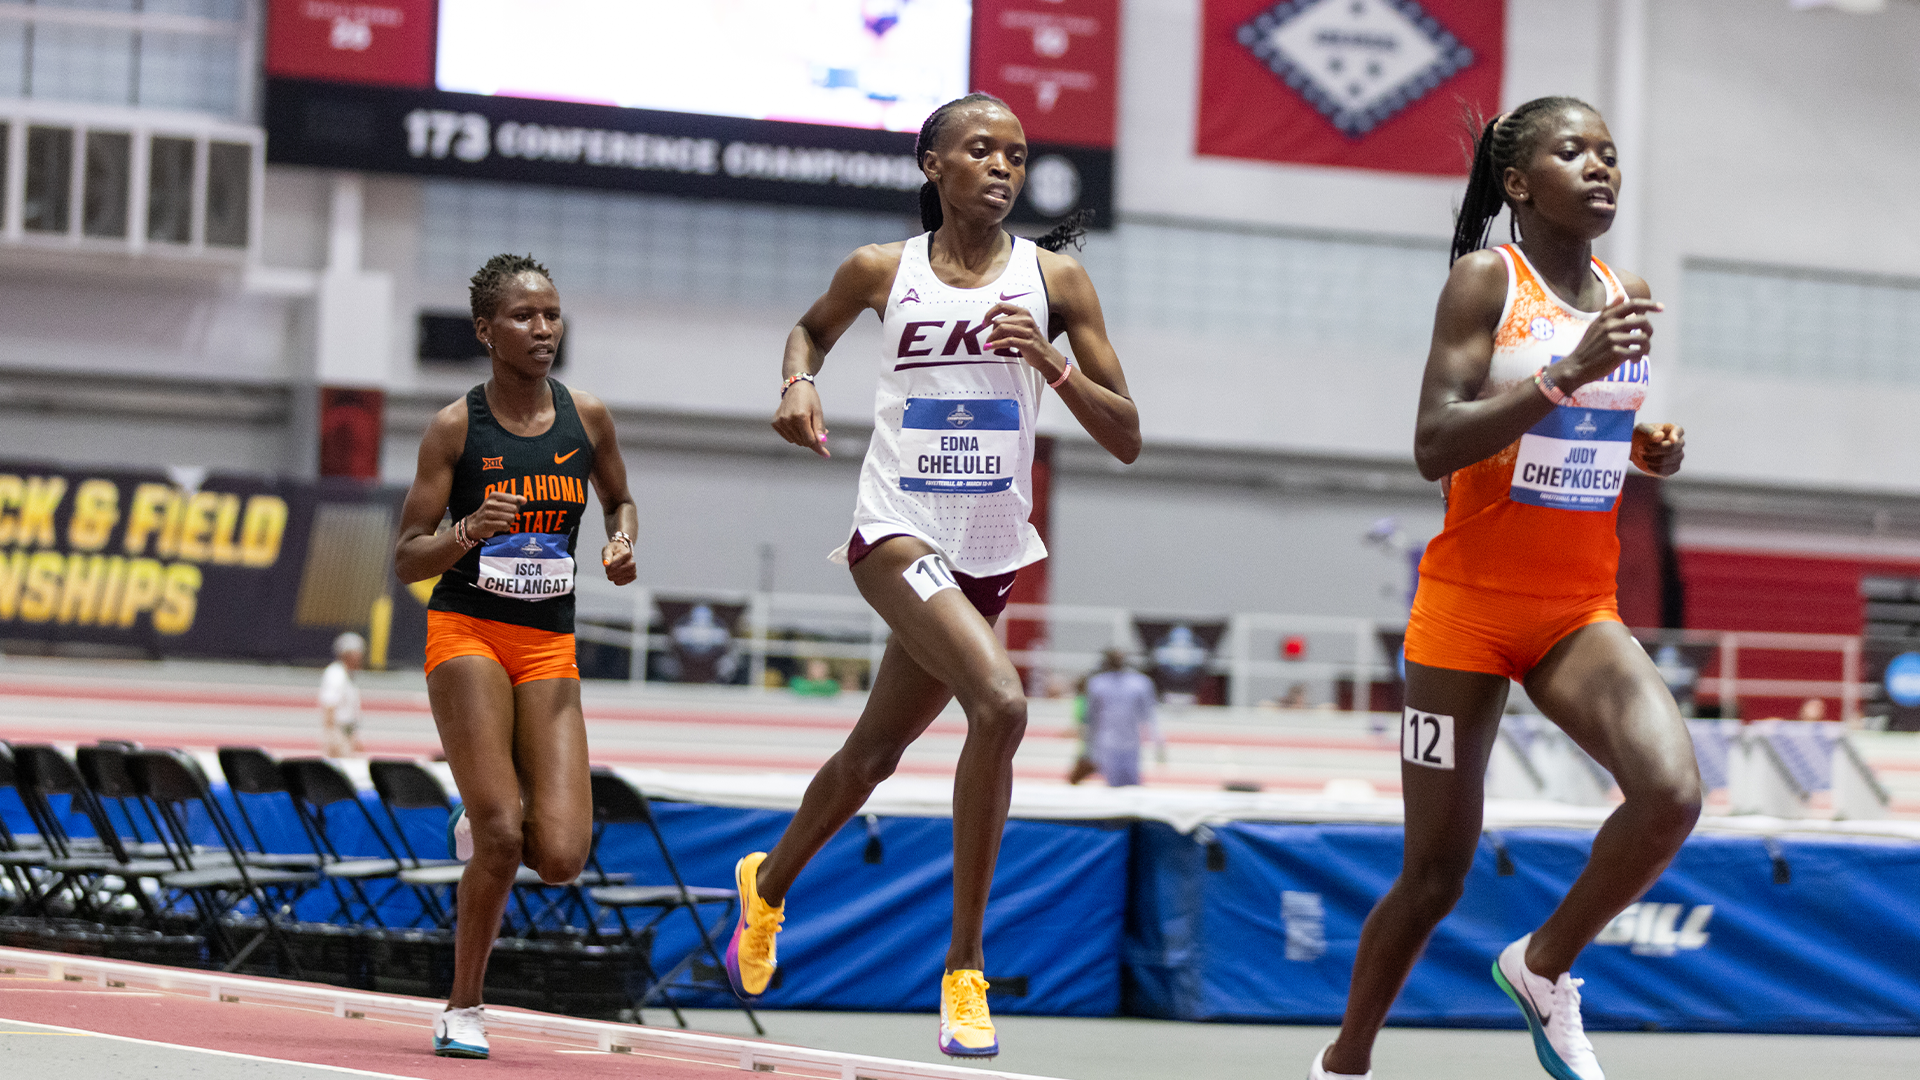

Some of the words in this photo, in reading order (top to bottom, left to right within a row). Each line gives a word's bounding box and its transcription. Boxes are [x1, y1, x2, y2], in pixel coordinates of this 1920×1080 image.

[405, 108, 491, 162] 173
[496, 121, 719, 175] CONFERENCE
[897, 320, 1024, 358] EK
[940, 436, 979, 451] EDNA
[918, 455, 1000, 474] CHELULEI
[1564, 447, 1597, 464] JUDY
[1523, 463, 1622, 490] CHEPKOECH
[68, 479, 119, 550] &
[125, 483, 289, 568] FIELD
[510, 511, 567, 533] STATE
[515, 563, 542, 576] ISCA
[484, 577, 568, 595] CHELANGAT
[1410, 713, 1441, 764] 12
